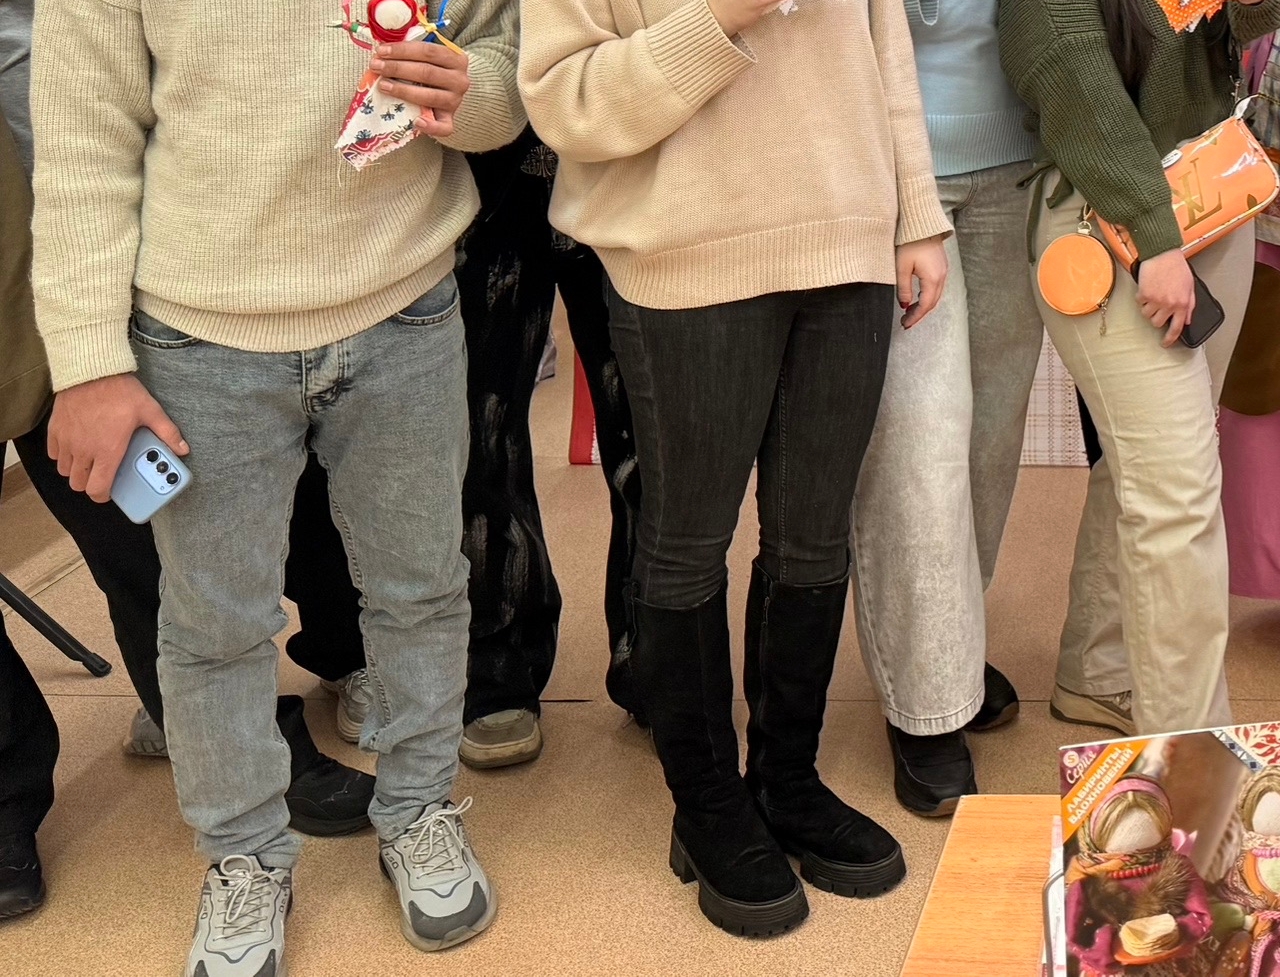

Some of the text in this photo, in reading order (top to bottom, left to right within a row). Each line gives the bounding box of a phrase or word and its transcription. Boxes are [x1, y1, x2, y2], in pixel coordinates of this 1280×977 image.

[1066, 750, 1098, 784] Серия
[1067, 747, 1122, 813] ЛАБИРИНТЫ
[1068, 743, 1134, 824] ВДОХНОВЕНИЙ
